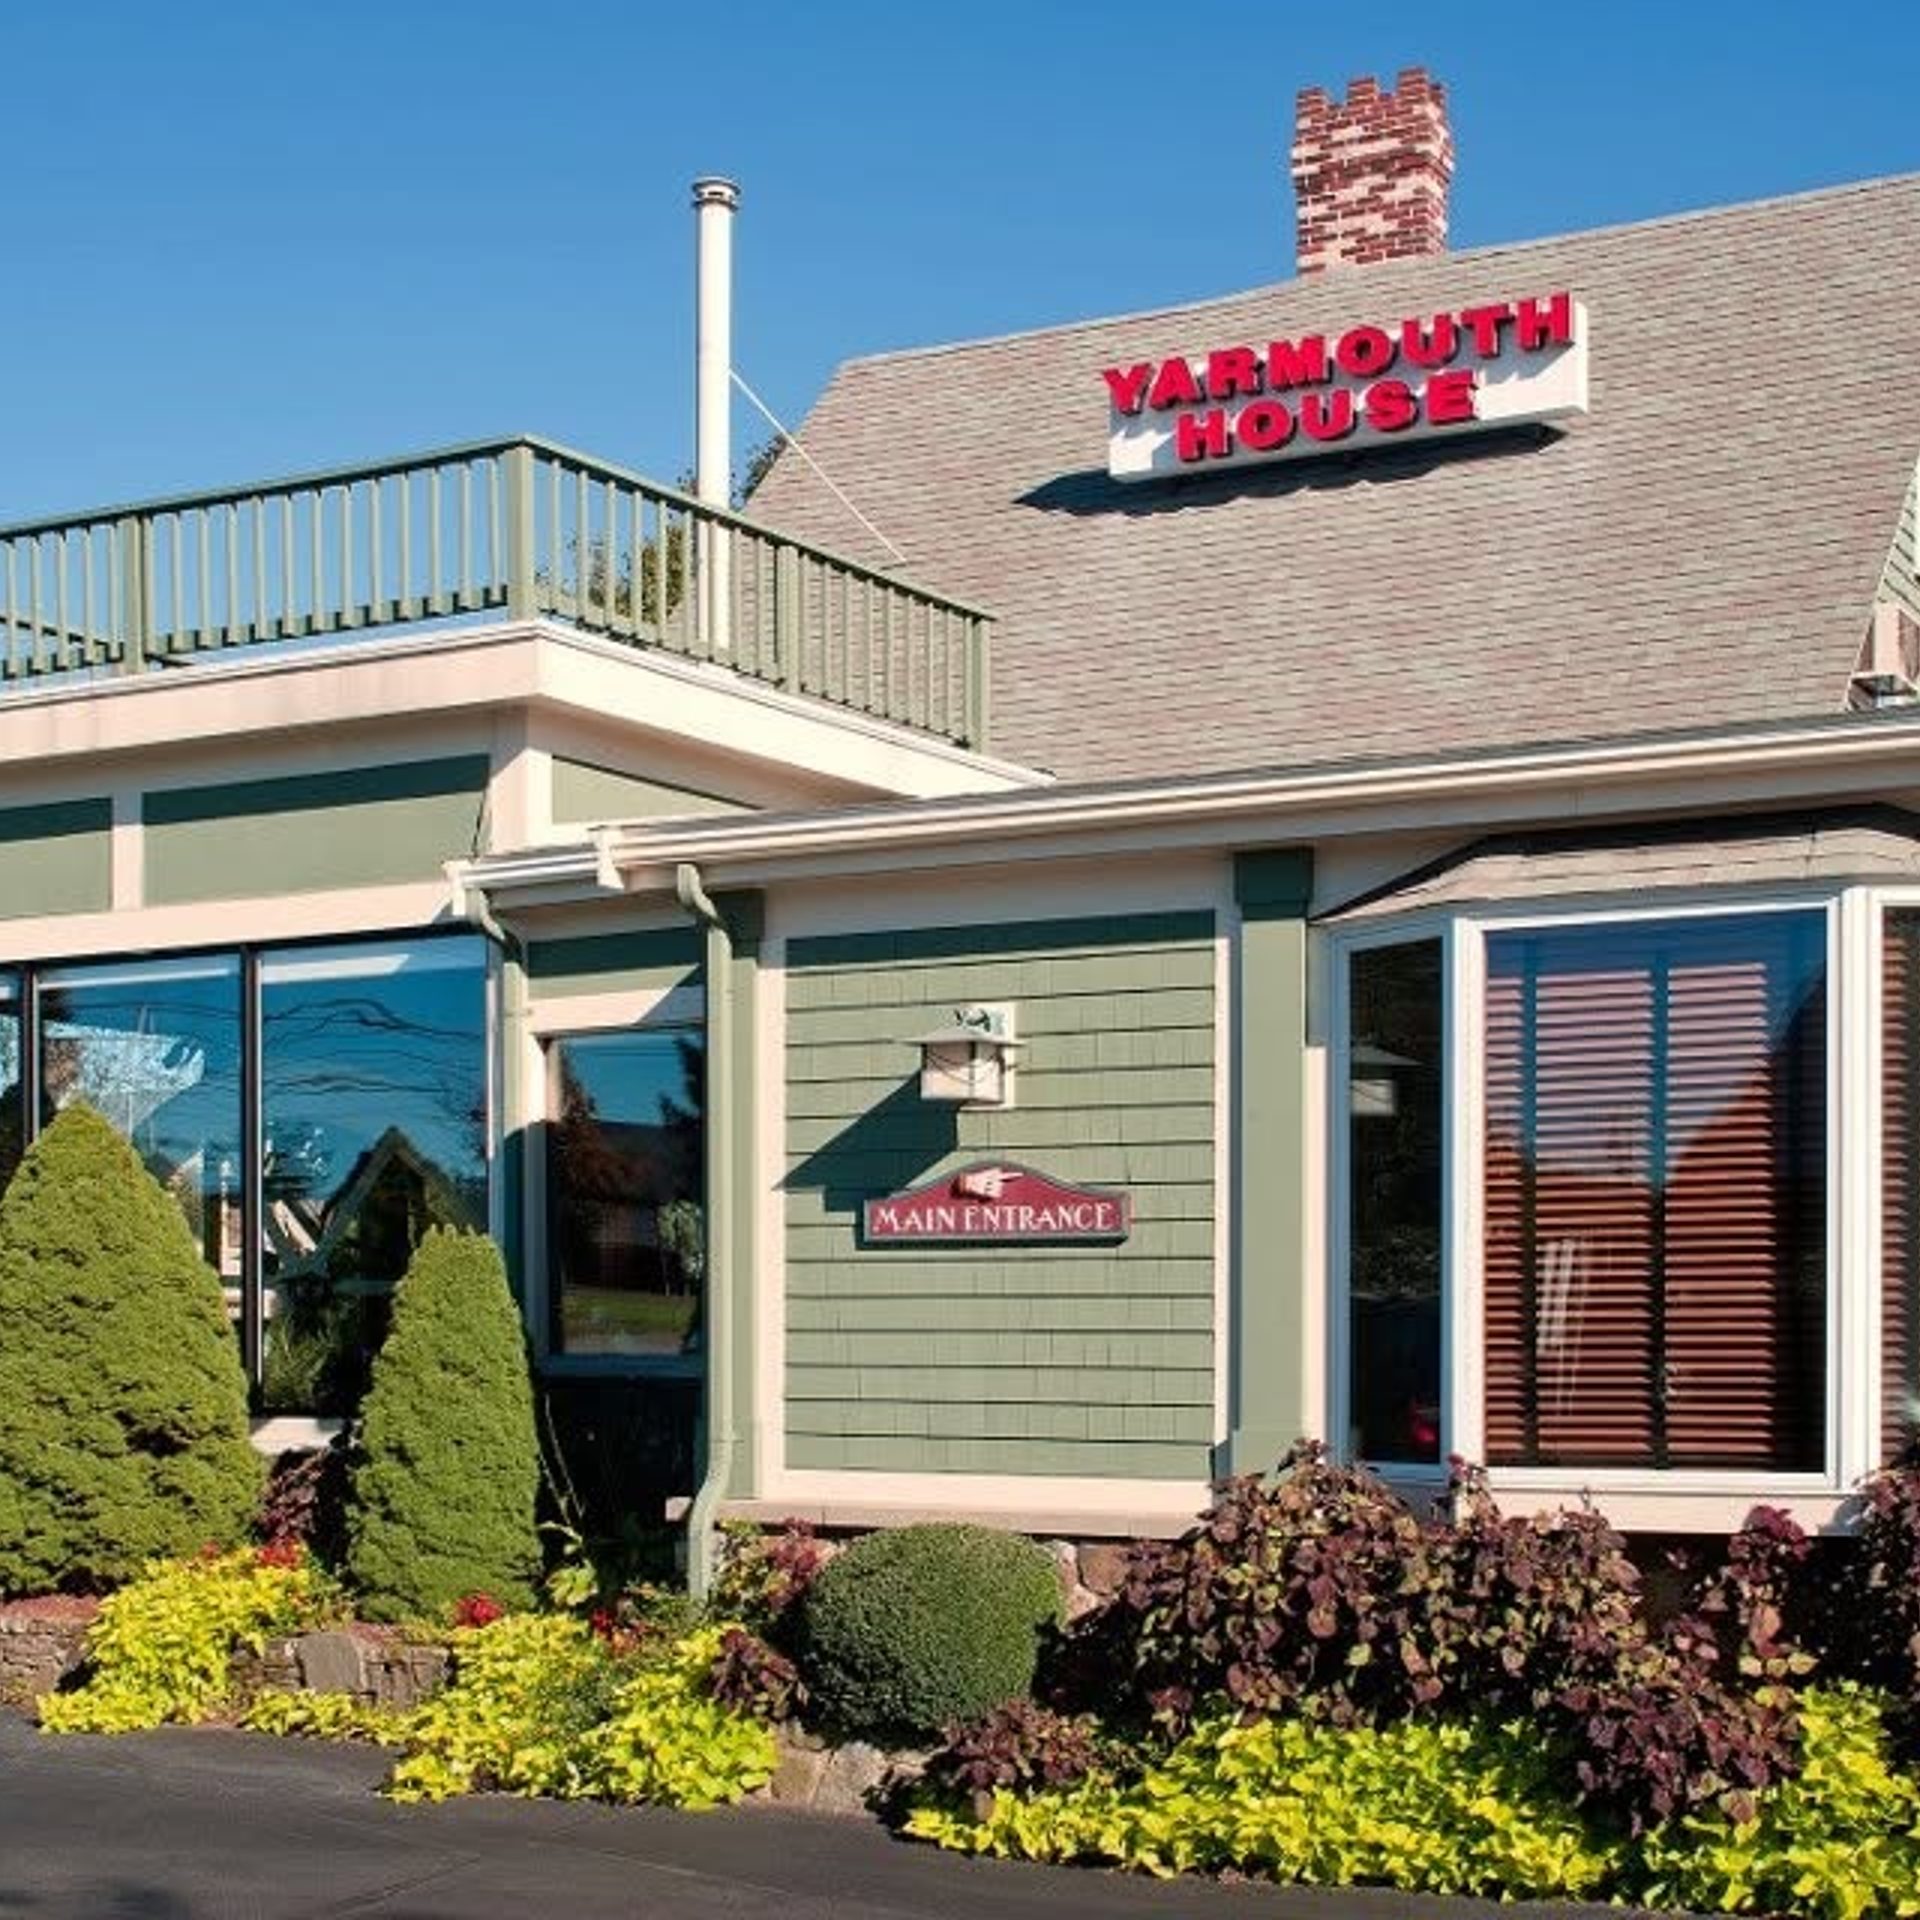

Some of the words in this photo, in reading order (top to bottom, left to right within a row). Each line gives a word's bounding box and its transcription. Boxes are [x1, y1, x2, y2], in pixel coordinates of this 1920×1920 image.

[1102, 291, 1574, 414] YARMOUTH
[1175, 370, 1478, 462] HOUSE
[873, 1206, 955, 1233] MAIN
[964, 1202, 1114, 1232] ENTRANCE
